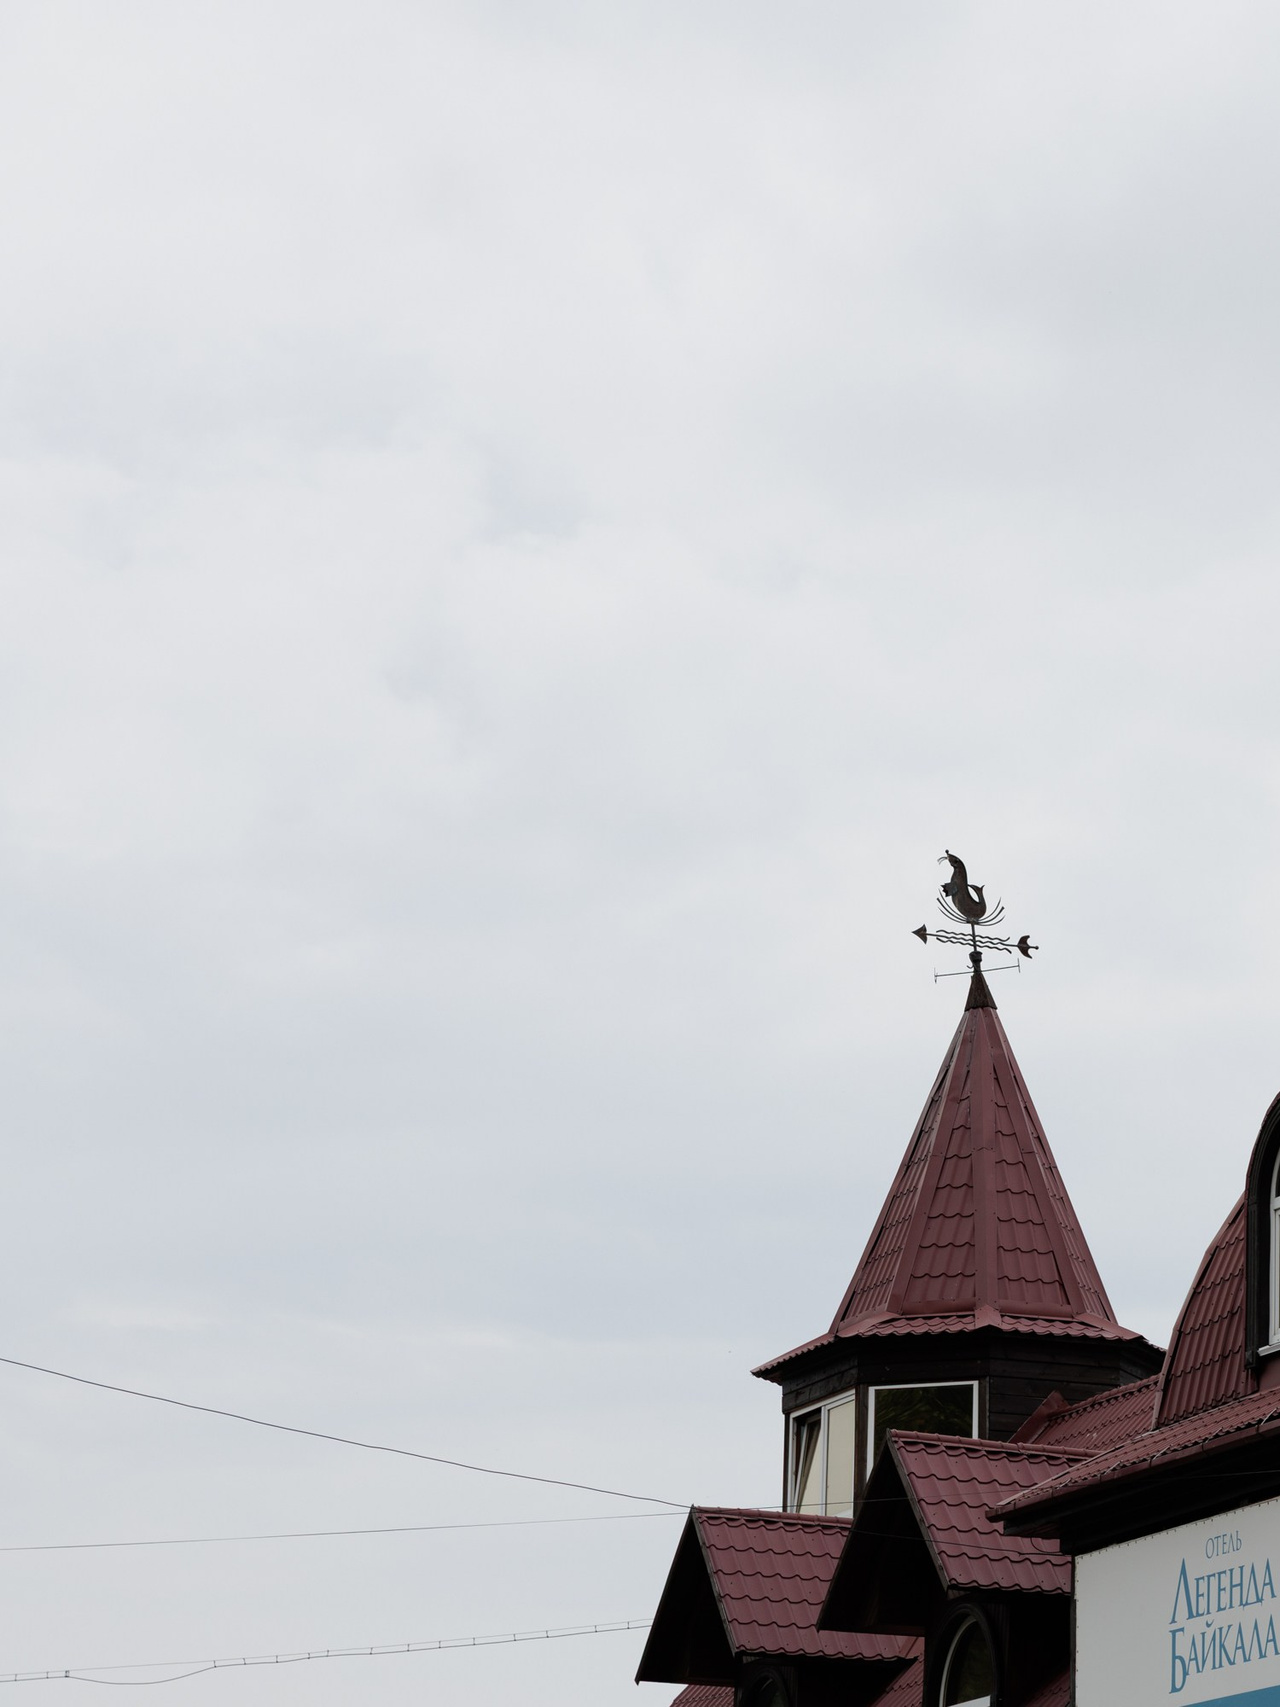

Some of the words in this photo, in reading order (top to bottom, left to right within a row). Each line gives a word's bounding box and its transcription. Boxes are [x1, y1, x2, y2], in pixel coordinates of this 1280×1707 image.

[1205, 1530, 1242, 1559] ОТЕЛЬ
[1169, 1557, 1277, 1625] ЛЕГЕНДА
[1169, 1613, 1280, 1694] БАЙКАЛА
